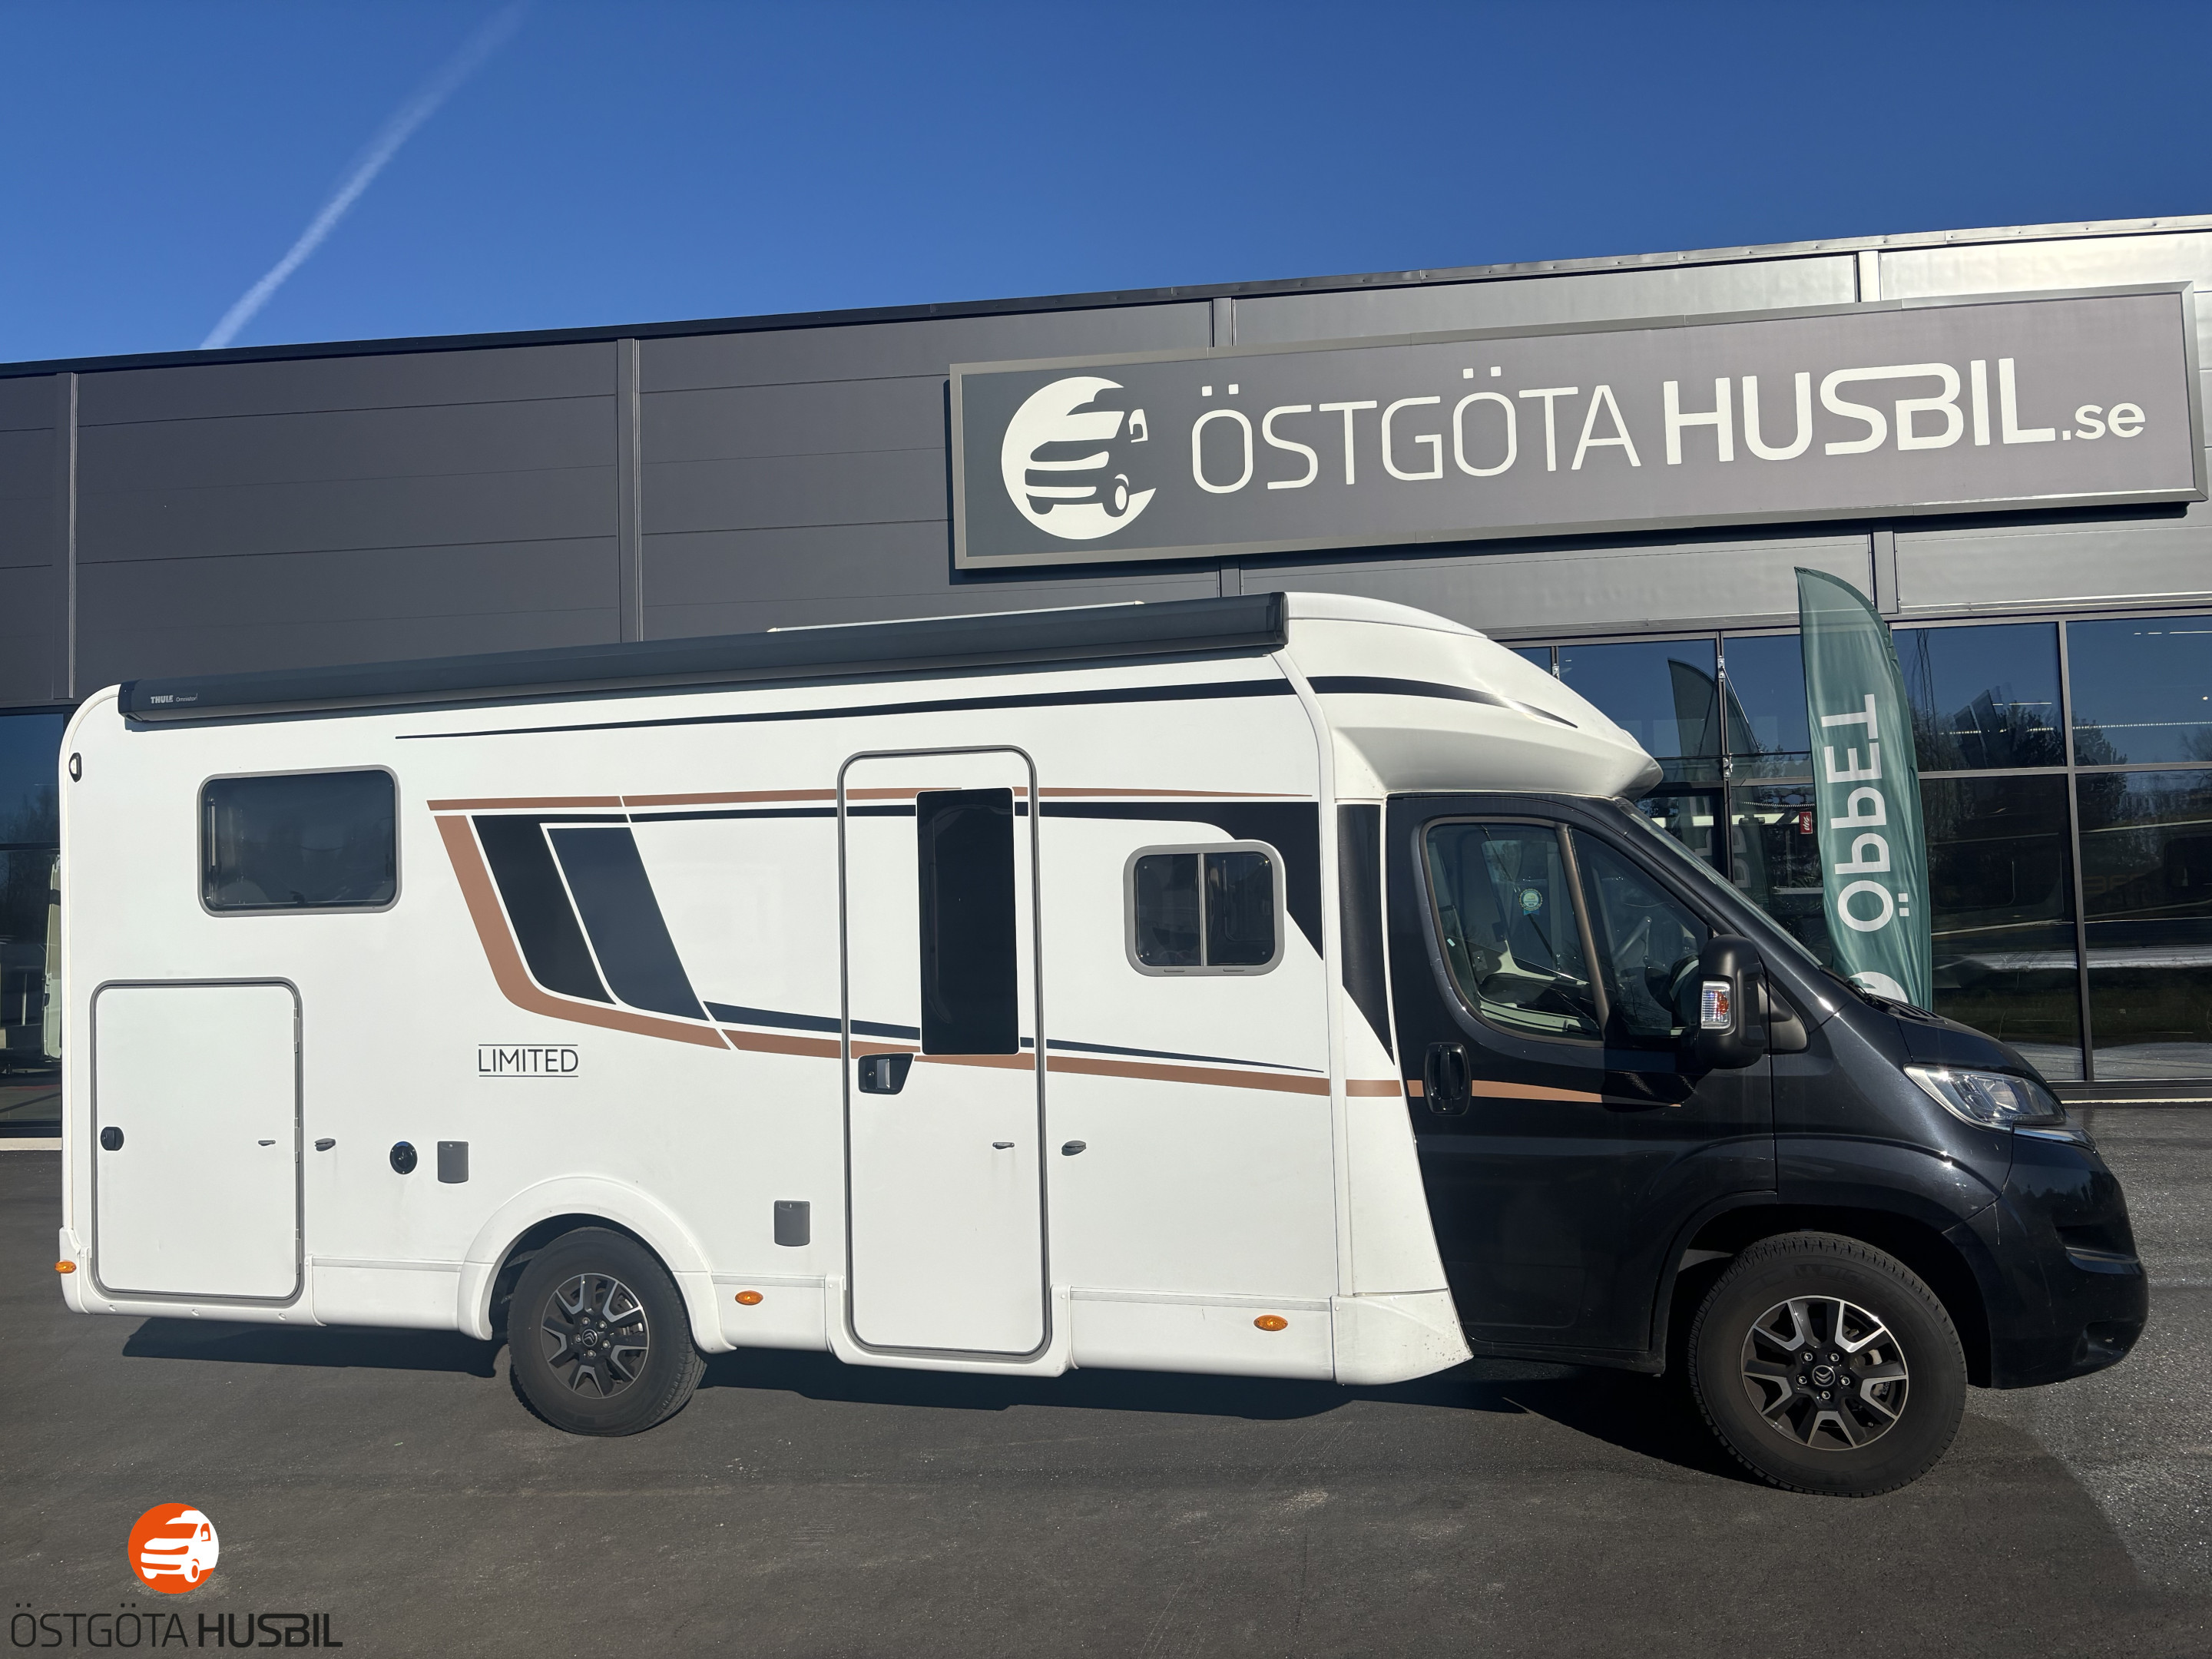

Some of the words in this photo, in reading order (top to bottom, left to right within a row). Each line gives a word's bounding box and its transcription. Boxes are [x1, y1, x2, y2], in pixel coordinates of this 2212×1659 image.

[1191, 366, 1642, 494] ÖSTGÖTA
[150, 694, 174, 704] THULE
[478, 1048, 579, 1073] LIMITED
